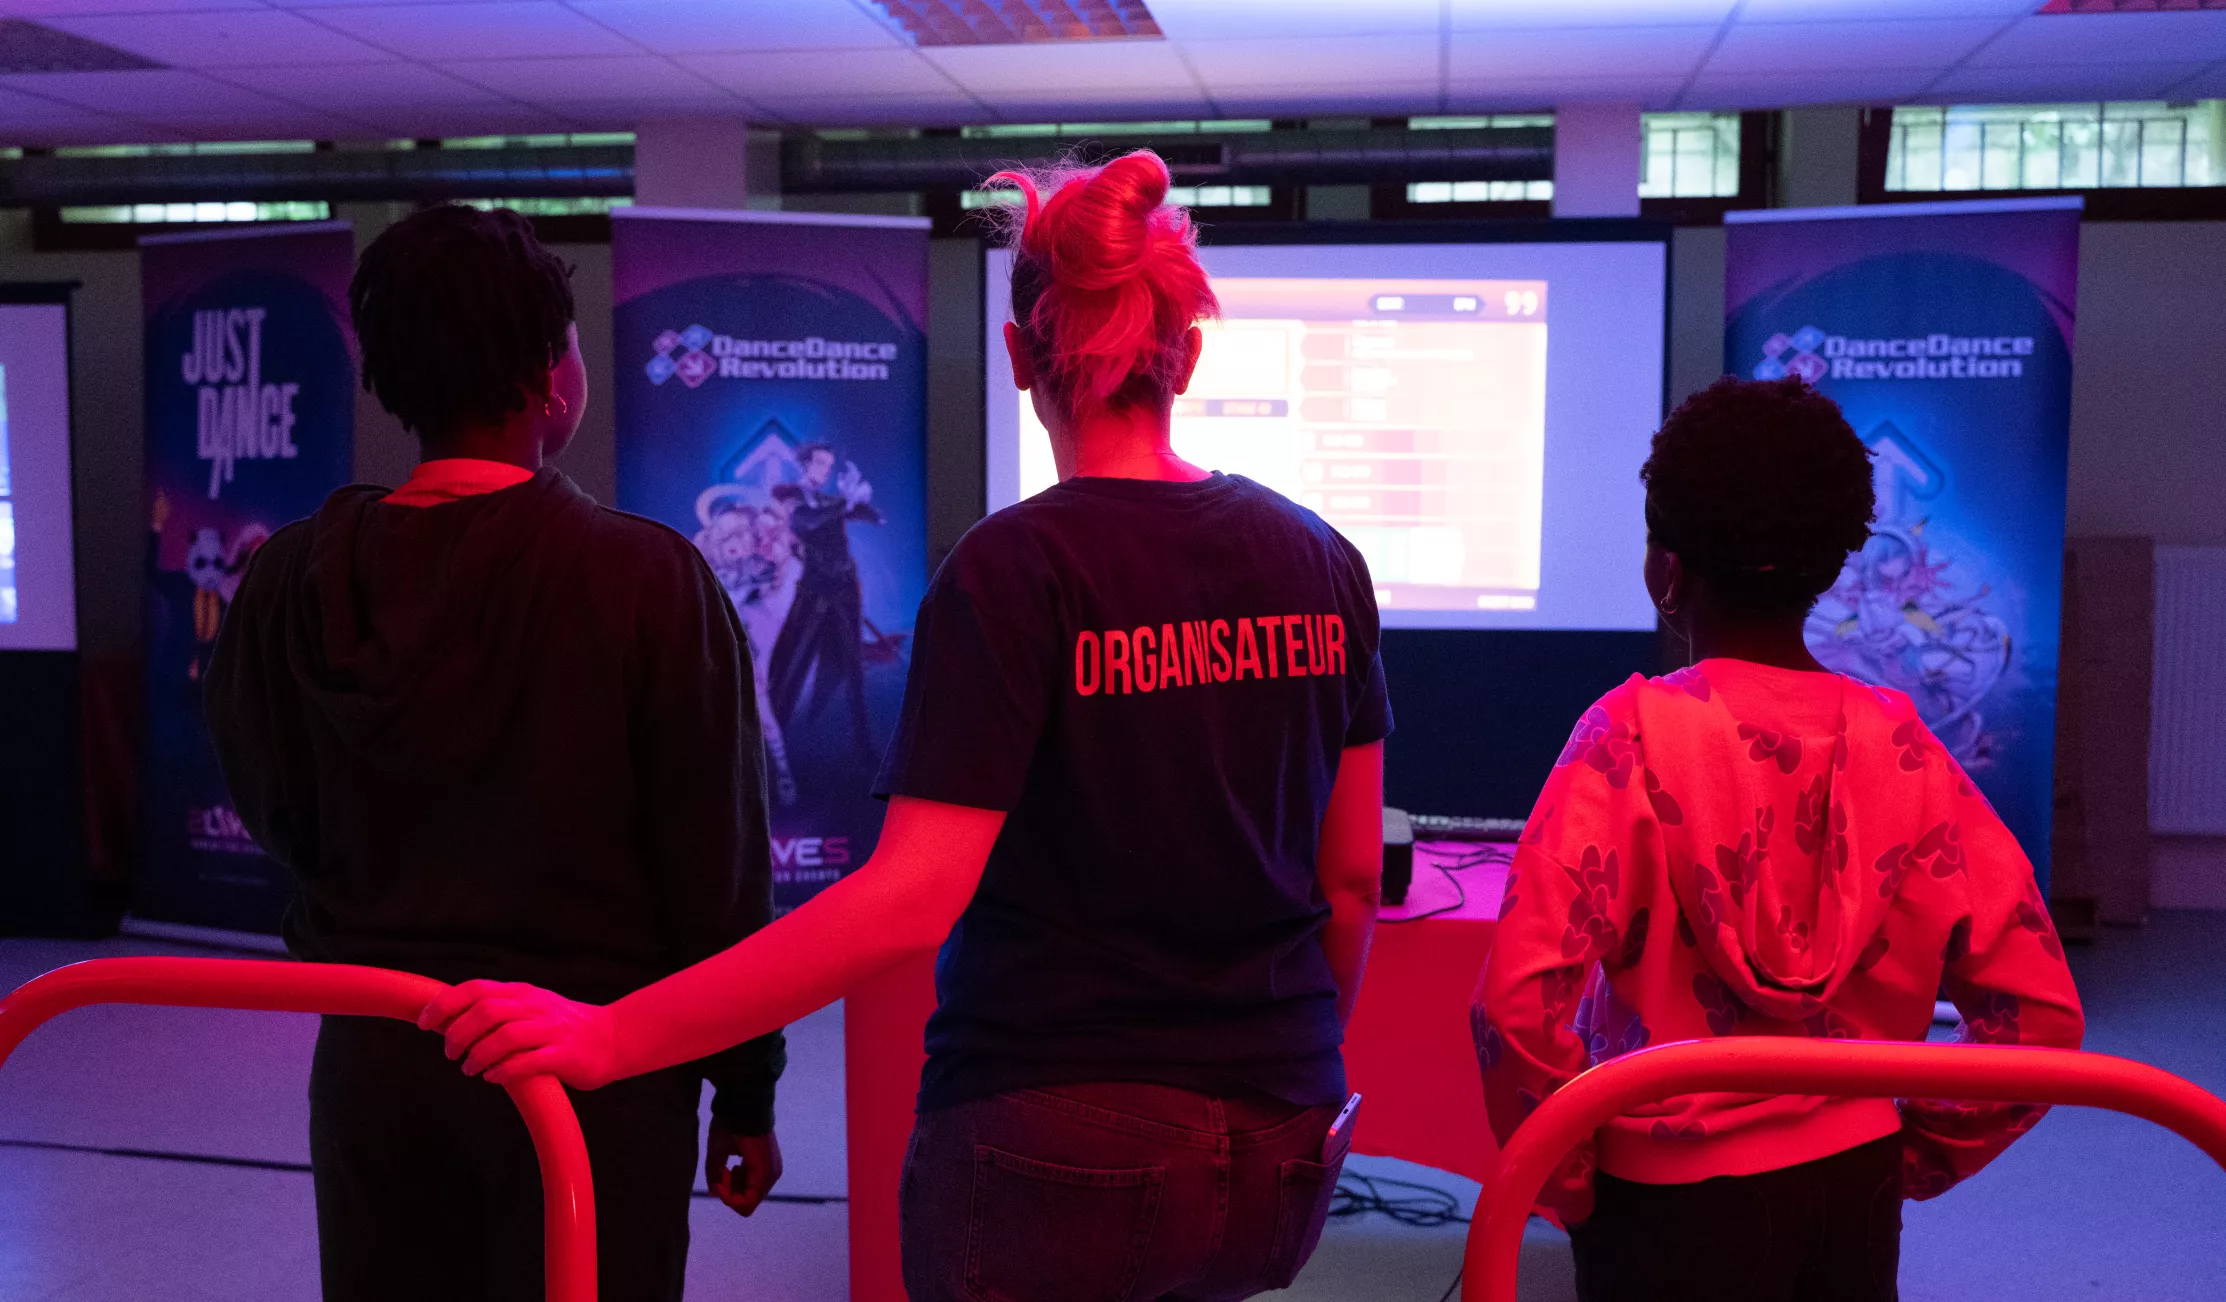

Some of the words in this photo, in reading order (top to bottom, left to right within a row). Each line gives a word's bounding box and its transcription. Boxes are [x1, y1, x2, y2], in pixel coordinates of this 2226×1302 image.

[181, 307, 266, 386] JUST
[711, 335, 897, 360] DanceDance
[1824, 334, 2034, 357] DanceDance
[719, 357, 888, 380] Revolution
[1831, 355, 2023, 379] Revolution
[197, 382, 299, 499] DANCE
[1075, 614, 1346, 697] ORGANISATEUR
[770, 836, 850, 867] VES
